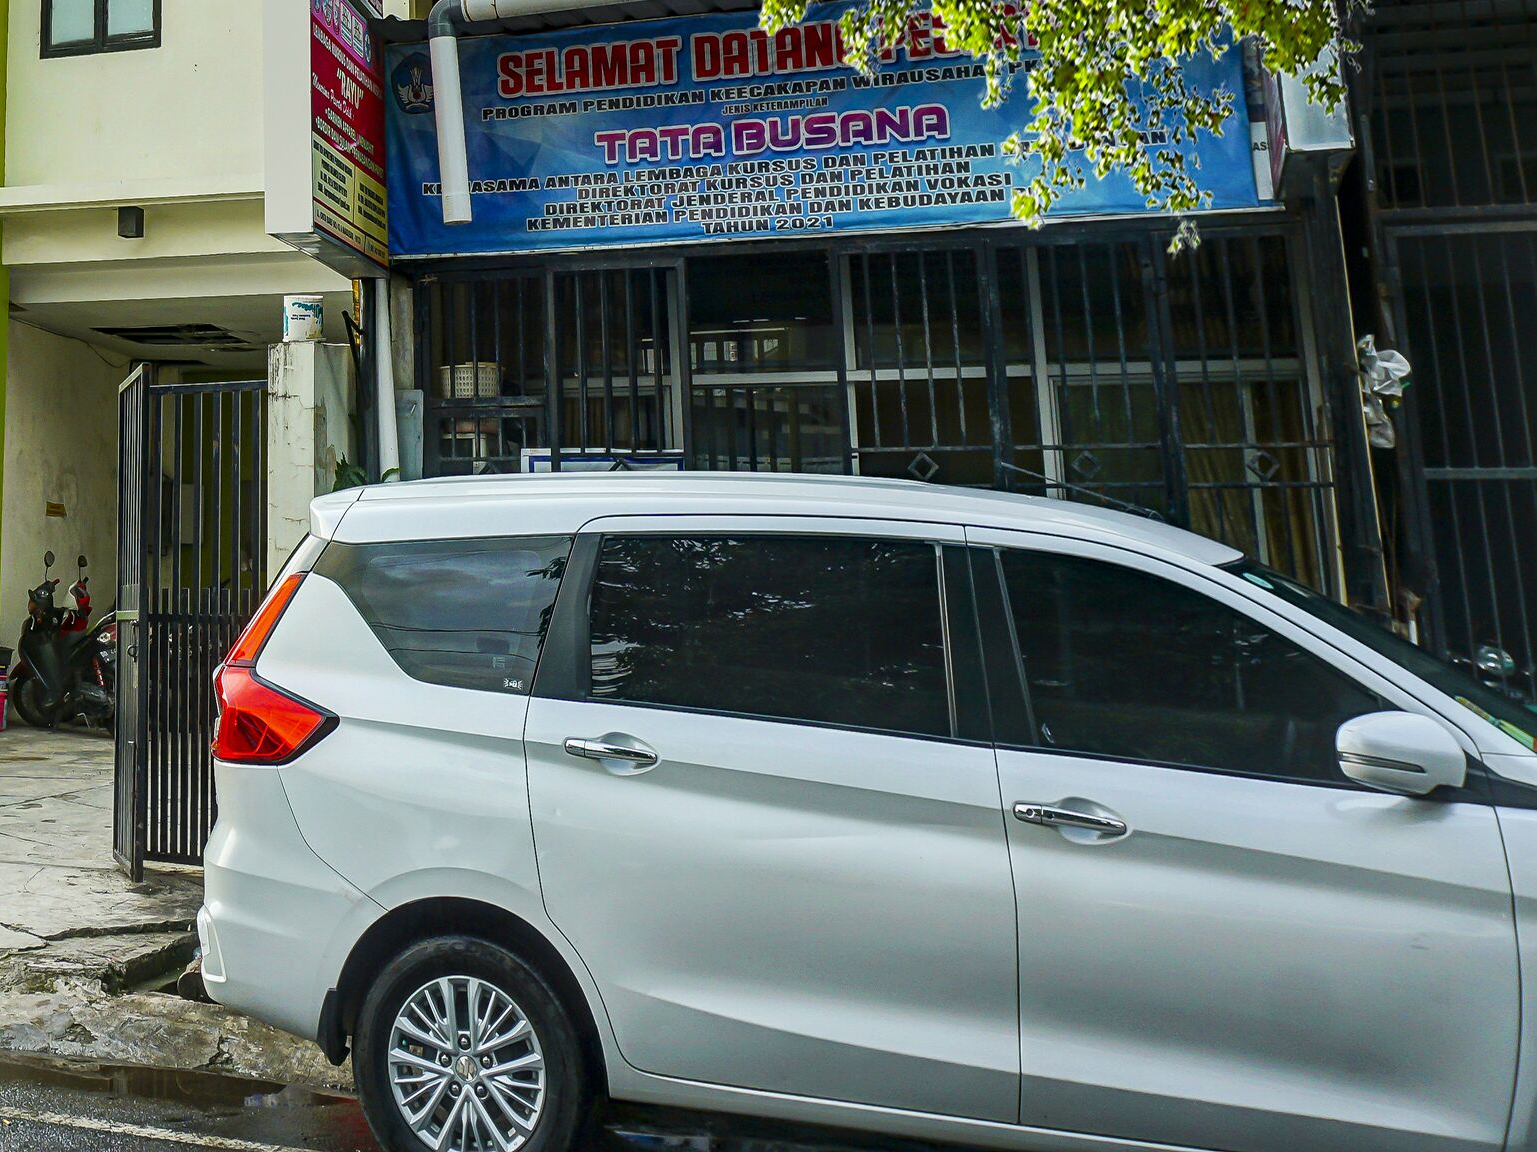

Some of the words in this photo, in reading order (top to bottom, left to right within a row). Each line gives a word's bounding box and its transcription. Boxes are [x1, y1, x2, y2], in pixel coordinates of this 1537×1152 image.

[500, 37, 680, 96] SELAMAT
[482, 101, 577, 121] PROGRAM
[583, 90, 704, 112] PENDIDIKAN
[711, 77, 846, 103] KEECAKAPAN
[722, 104, 751, 115] JENIS
[753, 97, 828, 113] KETERAMPILAN
[595, 123, 724, 164] TATA
[732, 103, 950, 155] BUSANA
[545, 171, 618, 189] ANTARA
[624, 163, 723, 183] LEMBAGA
[727, 156, 816, 177] KURSUS
[823, 152, 866, 169] DAN
[873, 142, 995, 165] PELATIHAN
[577, 180, 700, 200] DIREKTORAT
[705, 173, 795, 193] KURSUS
[800, 169, 844, 185] DAN
[849, 160, 971, 182] PELATIHAN
[526, 210, 668, 232] KEMENTERIAN
[674, 202, 805, 223] PENDIDIKAN
[809, 198, 852, 214] DAN
[858, 188, 1005, 211] KEBUDAYAAN
[544, 196, 666, 216] DIREKTORAT
[671, 189, 779, 209] JENDERAL
[785, 179, 920, 201] PENDIDIKAN
[926, 172, 1012, 191] VOKASI
[702, 217, 770, 235] TAHUN
[776, 215, 834, 230] 2021
